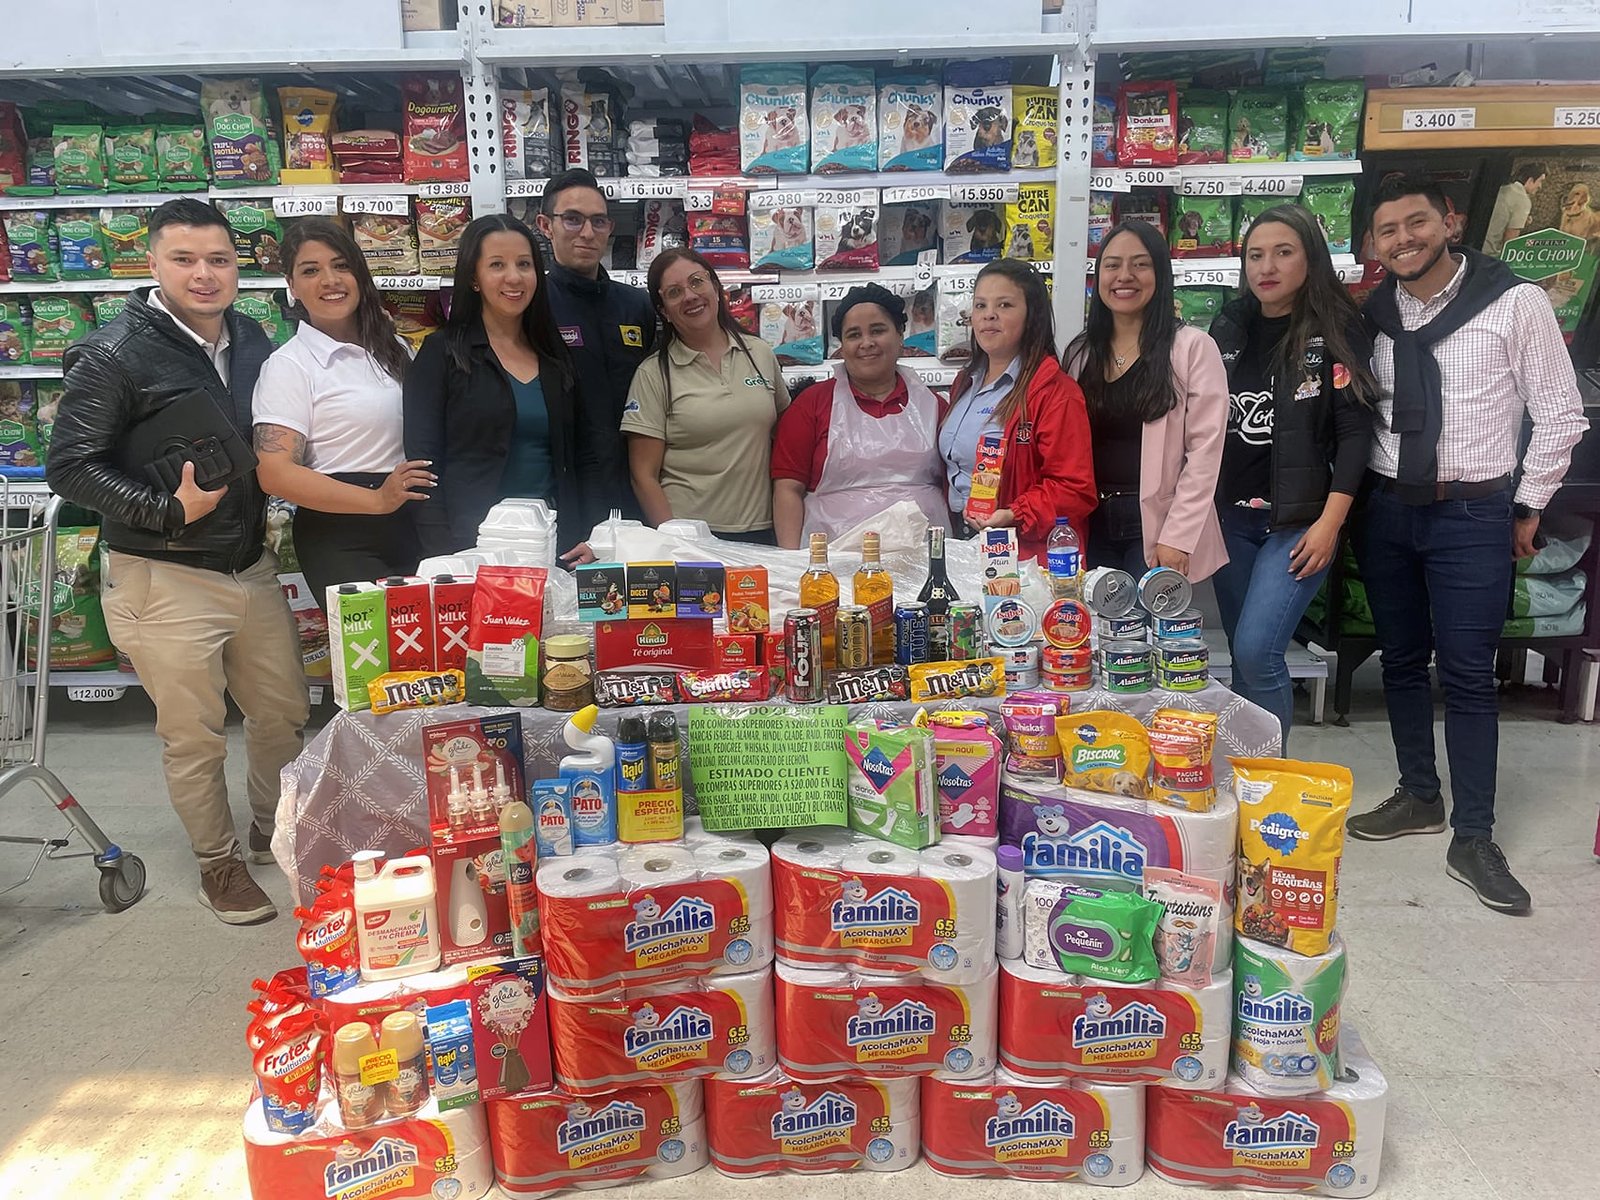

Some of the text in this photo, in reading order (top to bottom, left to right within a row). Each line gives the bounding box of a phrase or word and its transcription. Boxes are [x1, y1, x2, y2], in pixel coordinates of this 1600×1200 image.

[745, 93, 797, 106] Chunky
[887, 92, 937, 105] Chunky
[952, 93, 1004, 107] Chunky
[1025, 97, 1058, 107] NUTRE
[407, 101, 457, 116] Dogourmet
[1026, 107, 1058, 121] CAN
[1133, 116, 1164, 125] Donkan
[1414, 113, 1456, 127] 3.400
[503, 98, 517, 159] RINGO
[565, 99, 580, 164] RINGO
[1125, 171, 1164, 183] 5.600
[426, 184, 469, 195] 19.980
[505, 184, 543, 195] 6.800
[630, 184, 673, 195] 16.100
[1183, 181, 1224, 194] 5.750
[1244, 180, 1286, 192] 4.400
[758, 193, 802, 206] 22.980
[816, 192, 861, 205] 22.980
[891, 187, 935, 200] 17.500
[959, 188, 1004, 201] 15.950
[1018, 189, 1049, 199] NUTRE
[281, 201, 323, 213] 17.300
[350, 200, 393, 212] 19.700
[1018, 198, 1049, 212] CAN
[1506, 248, 1578, 263] DOG CHOW
[380, 277, 424, 288] 20.980
[1184, 272, 1224, 283] 5.750
[759, 289, 802, 300] 22.980
[980, 541, 1016, 554] Isabel
[630, 589, 648, 597] DIGEST
[391, 604, 415, 616] NOT
[438, 603, 462, 614] NOT
[996, 608, 1024, 619] Isabel
[344, 611, 368, 623] NOT
[391, 613, 420, 625] MILK
[438, 611, 466, 622] MILK
[482, 615, 531, 625] Juan Valdez
[1053, 610, 1083, 622] Isabel
[344, 620, 373, 633] MILK
[1117, 621, 1143, 633] Alamar
[1167, 622, 1196, 632] Alamar
[639, 635, 666, 645] Hindú
[632, 647, 673, 659] Té original
[1169, 654, 1199, 664] Alamar
[1113, 656, 1142, 666] Alamar
[1117, 675, 1146, 686] Alamar
[1171, 674, 1200, 684] Alamar
[691, 677, 751, 696] Skittles
[73, 688, 115, 699] 112.000
[691, 720, 705, 730] POR
[707, 719, 740, 729] COMPRAS
[742, 719, 783, 730] SUPERIORES
[785, 720, 790, 729] A
[821, 718, 830, 728] EN
[831, 718, 844, 728] LAS
[1012, 722, 1045, 732] whiskas
[448, 740, 472, 758] glade
[955, 746, 974, 754] AQUÍ
[1076, 749, 1121, 763] BISCROK
[622, 759, 644, 779] Raid
[657, 757, 678, 776] Raid
[709, 766, 830, 780] ESTIMADO CLIENTE
[863, 759, 895, 776] Nosotras
[705, 780, 737, 793] COMPRAS
[739, 780, 782, 791] SUPERIORES
[783, 780, 789, 790] A
[791, 778, 819, 789] $20.000
[821, 777, 830, 788] EN
[832, 777, 844, 789] LAS
[937, 775, 973, 788] Nosotras
[573, 797, 602, 811] PATO
[638, 799, 675, 808] PRECIO
[634, 807, 680, 817] ESPECIAL
[540, 815, 565, 827] PATO
[1249, 818, 1310, 841] Pedigree
[1023, 834, 1144, 877] familia
[1272, 871, 1296, 880] RAZAS
[1272, 877, 1323, 890] PEQUEÑAS
[1034, 897, 1053, 908] 100
[832, 896, 918, 923] familia
[305, 911, 347, 945] Frotex
[625, 905, 715, 945] familia
[730, 917, 749, 928] 65
[935, 919, 955, 930] 65
[367, 923, 421, 937] DESMANCHADOR
[389, 929, 418, 940] CREMA
[843, 927, 909, 939] AcolchaMAX
[638, 935, 706, 958] AcolchaMAX
[851, 937, 902, 945] MEGAROLLO
[1064, 935, 1104, 950] Pequeñín
[647, 945, 698, 963] MEGAROLLO
[1090, 963, 1130, 974] Aloe Vera
[493, 987, 523, 1009] glade
[848, 1008, 934, 1039] familia
[1074, 1009, 1164, 1040] familia
[625, 1015, 712, 1051] familia
[728, 1026, 747, 1037] 65
[950, 1026, 970, 1036] 65
[1242, 1024, 1304, 1039] AcolchaMAX
[859, 1035, 924, 1053] AcolchaMAX
[1181, 1033, 1202, 1044] 65
[1276, 1037, 1307, 1046] Decorada
[263, 1033, 313, 1072] Frotex
[639, 1042, 703, 1064] AcolchaMAX
[867, 1045, 918, 1058] MEGAROLLO
[1085, 1039, 1153, 1055] AcolchaMAX
[365, 1053, 392, 1066] PRECIO
[437, 1049, 456, 1067] Raid
[647, 1051, 697, 1069] MEGAROLLO
[1093, 1050, 1146, 1062] MEGAROLLO
[274, 1053, 311, 1077] Multiusos
[362, 1059, 396, 1072] ESPECIAL
[772, 1099, 855, 1133] familia
[558, 1109, 644, 1146] familia
[986, 1108, 1073, 1140] familia
[784, 1129, 847, 1147] AcolchaMAX
[1226, 1120, 1318, 1145] familia
[571, 1132, 636, 1158] AcolchaMAX
[998, 1138, 1064, 1154] AcolchaMAX
[1236, 1149, 1306, 1160] AcolchaMAX
[326, 1143, 417, 1188] familia
